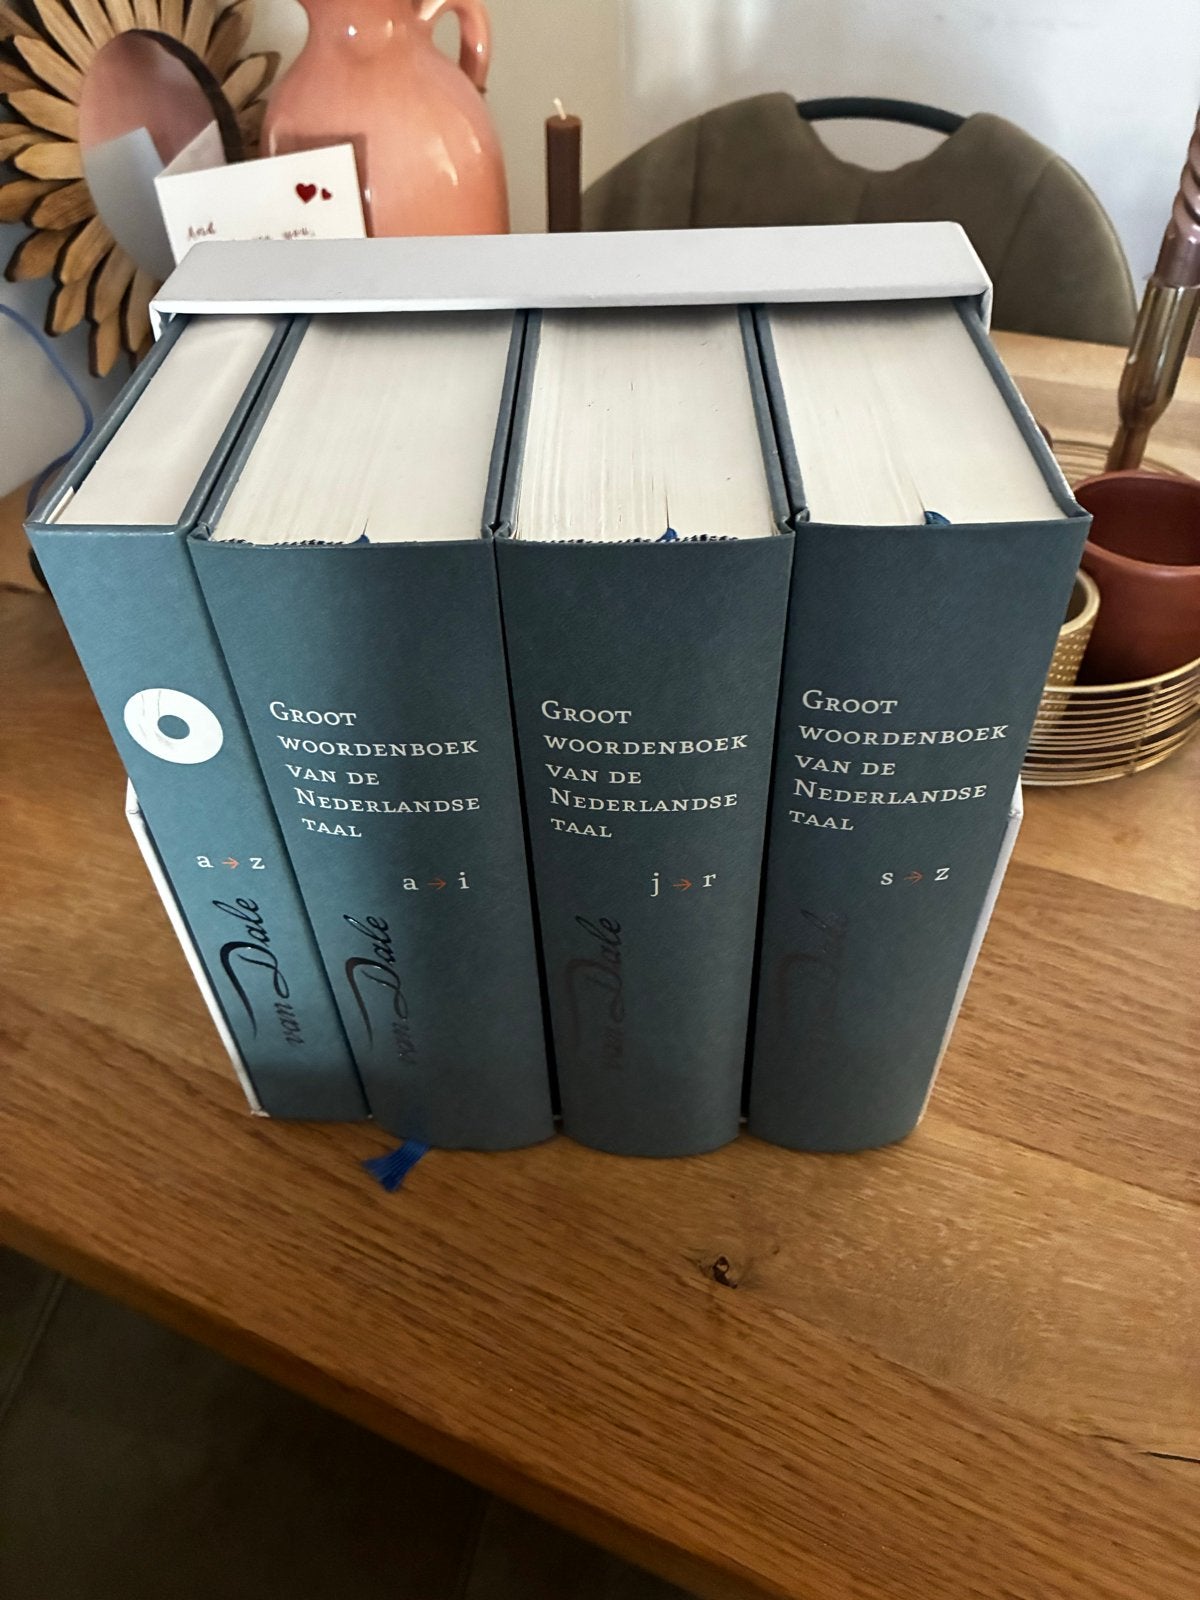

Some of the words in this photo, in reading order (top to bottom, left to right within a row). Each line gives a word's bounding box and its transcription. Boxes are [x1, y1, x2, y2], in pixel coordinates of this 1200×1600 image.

[196, 855, 214, 868] a
[249, 857, 266, 870] z
[402, 877, 419, 891] a
[457, 871, 470, 890] i
[650, 872, 661, 897] j
[702, 872, 717, 888] r
[880, 872, 895, 886] s
[934, 867, 951, 882] z
[212, 897, 290, 1041] Dale
[342, 913, 409, 1050] Dale
